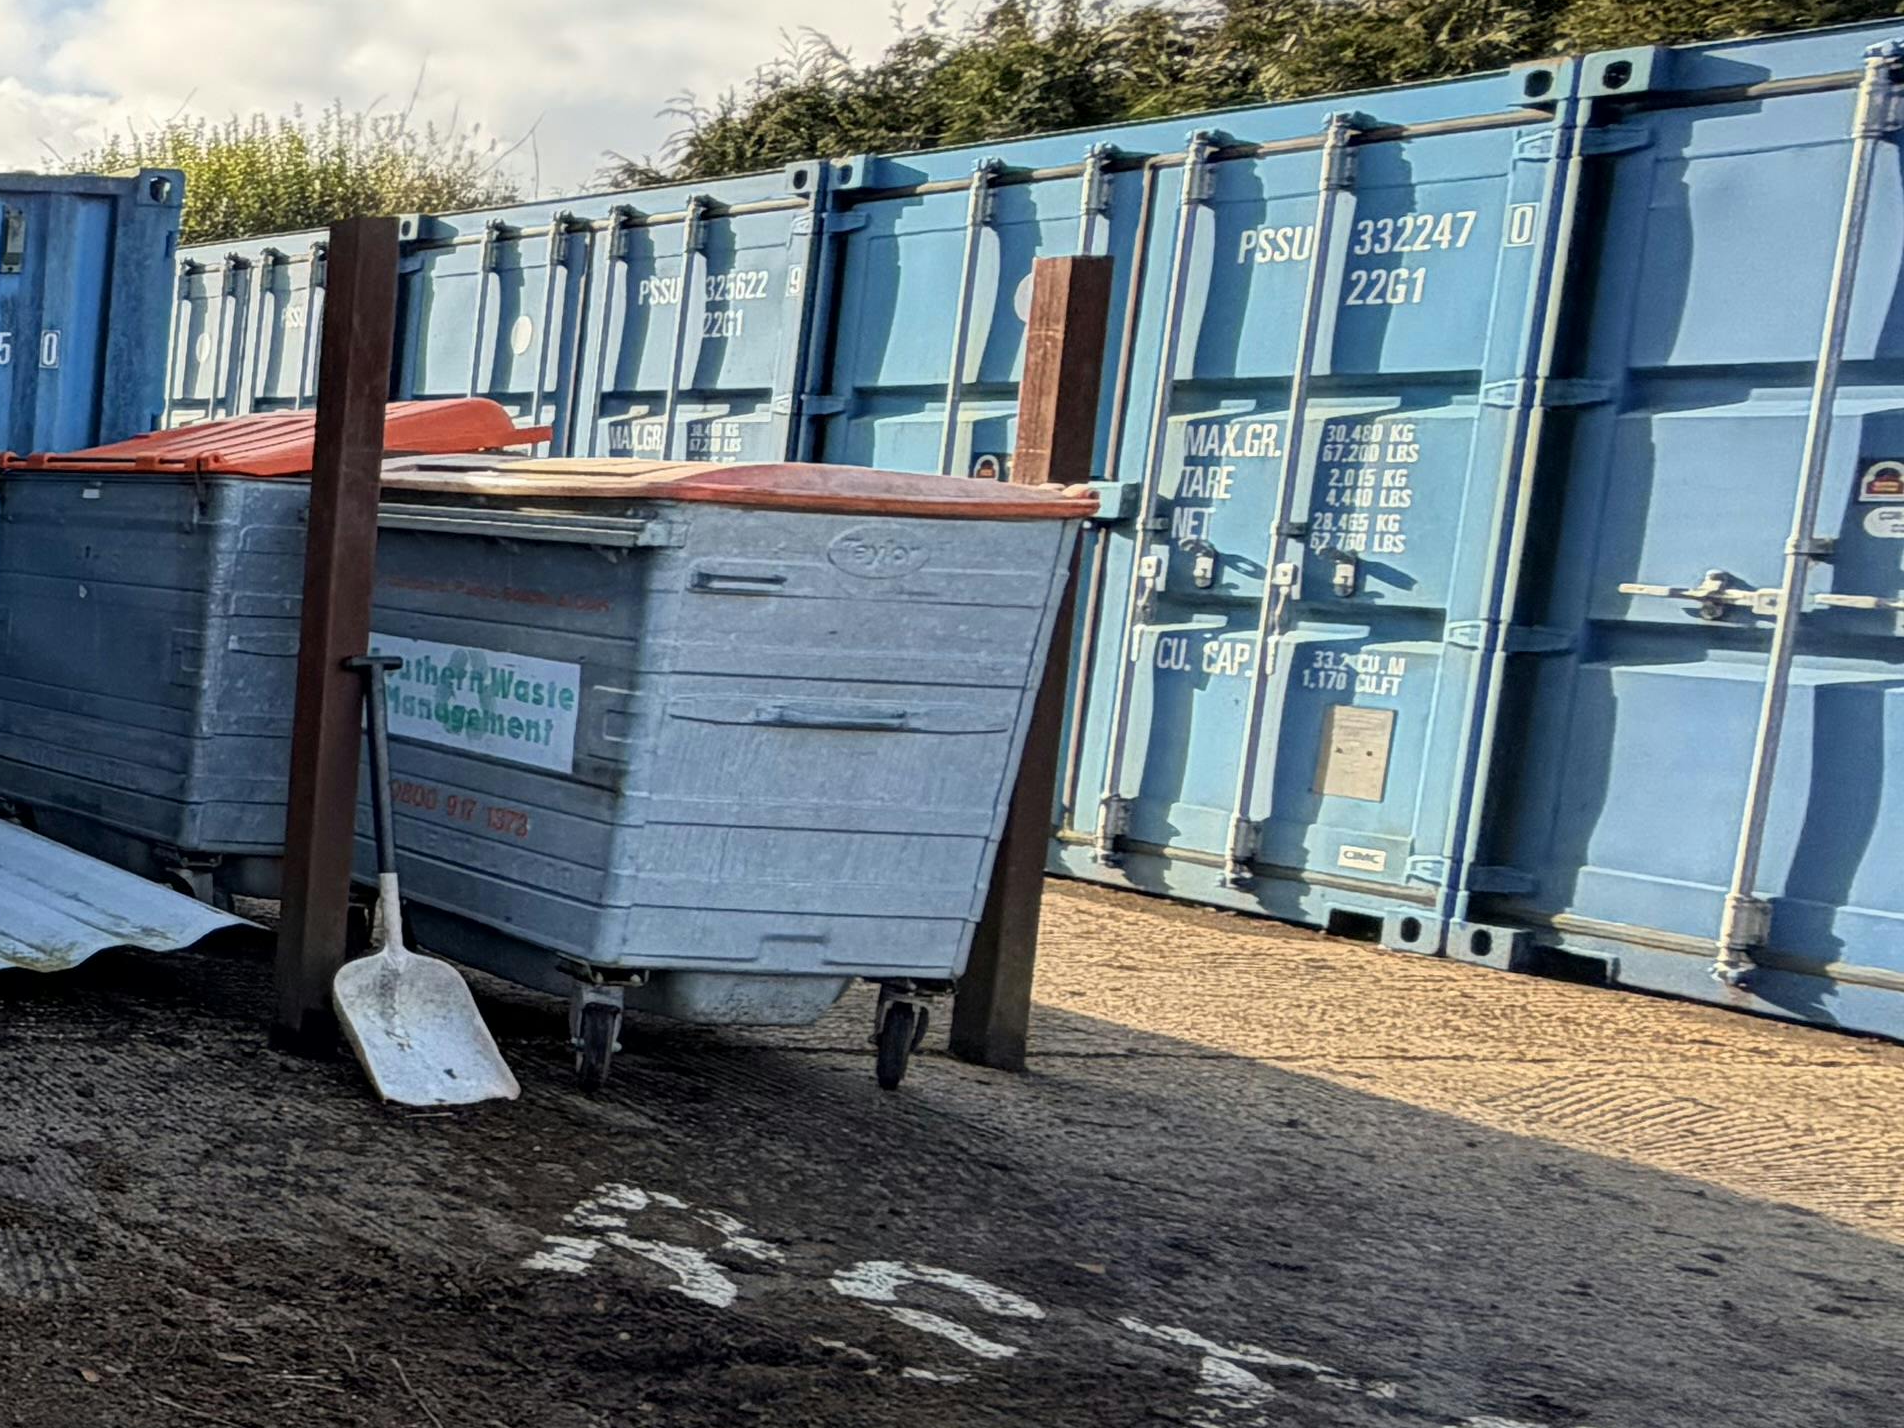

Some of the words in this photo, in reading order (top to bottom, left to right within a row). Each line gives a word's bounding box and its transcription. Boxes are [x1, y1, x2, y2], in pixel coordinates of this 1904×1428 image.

[1238, 224, 1314, 264] PSSU
[1353, 210, 1477, 255] 332247
[1508, 204, 1535, 245] 0
[638, 274, 682, 306] PSSU
[705, 269, 769, 301] 325622
[788, 266, 802, 294] 9
[1345, 267, 1427, 306] 22G1
[702, 309, 743, 338] 22G1
[41, 331, 59, 367] 0
[1184, 423, 1282, 458] MAX.GR.
[1326, 424, 1384, 443] 30.480
[1390, 424, 1416, 443] KG
[1322, 443, 1380, 463] 67.200
[1386, 444, 1421, 463] LBS
[1181, 465, 1236, 499] TARE
[1328, 468, 1377, 487] 2.015
[1382, 468, 1408, 487] KG
[1379, 488, 1412, 508] LBS
[1171, 506, 1217, 540] NET
[1312, 512, 1370, 532] 28.465
[1375, 513, 1402, 533] KG
[1373, 533, 1408, 553] LBS
[1157, 637, 1191, 671] CU.
[1202, 641, 1253, 678] CAP.
[371, 646, 490, 694] uthern
[491, 665, 575, 712] Waste
[1302, 669, 1348, 690] 1.170
